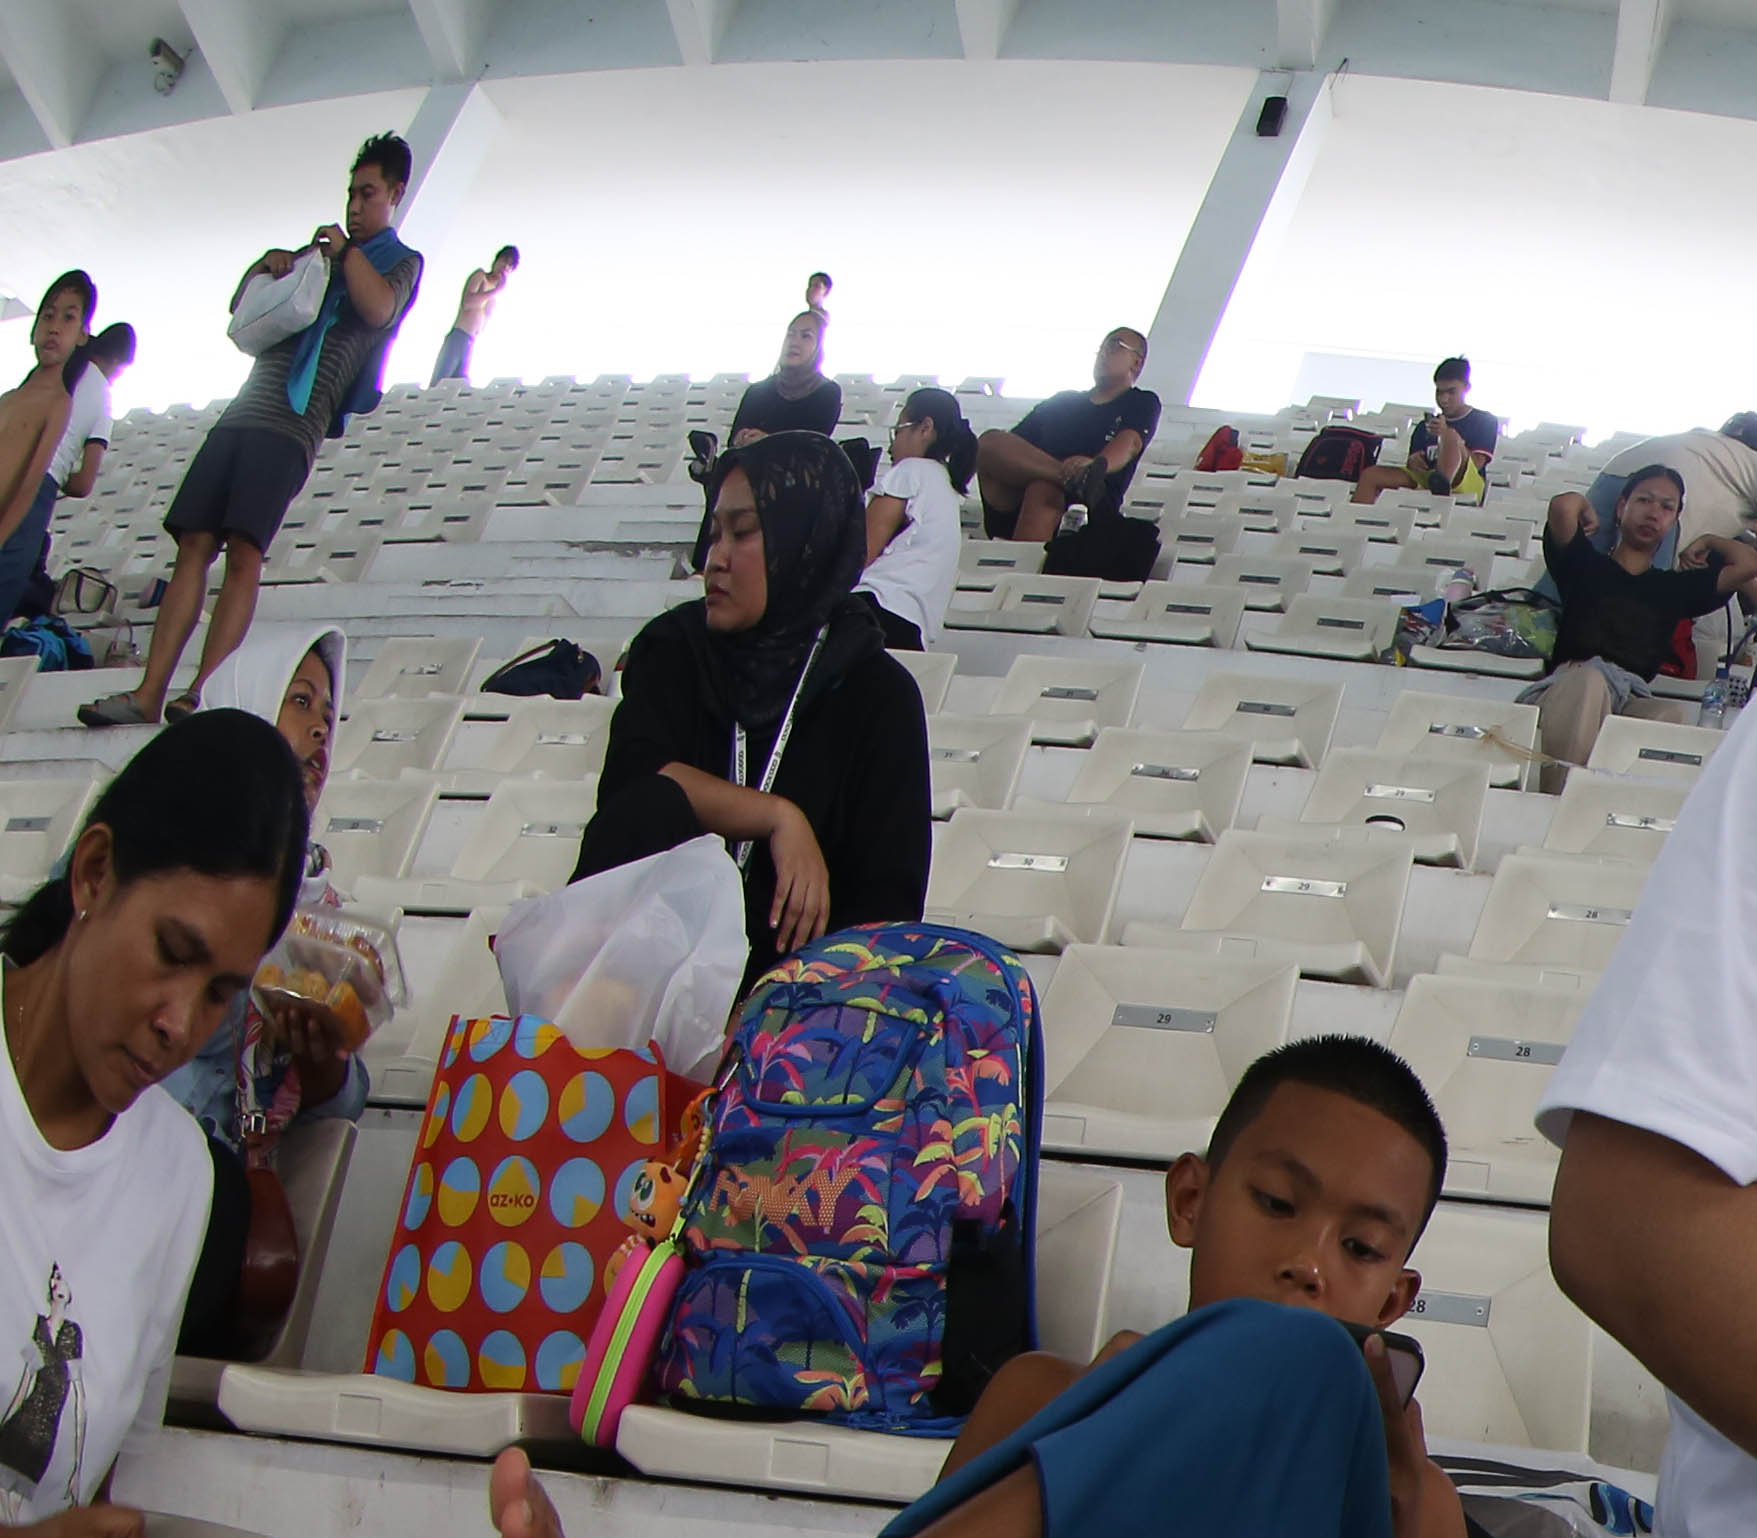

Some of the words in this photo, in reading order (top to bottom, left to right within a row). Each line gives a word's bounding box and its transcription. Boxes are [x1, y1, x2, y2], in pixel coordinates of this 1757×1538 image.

[1297, 881, 1311, 891] 29
[1585, 909, 1599, 920] 28
[1157, 1013, 1172, 1025] 29
[1514, 1045, 1532, 1058] 28
